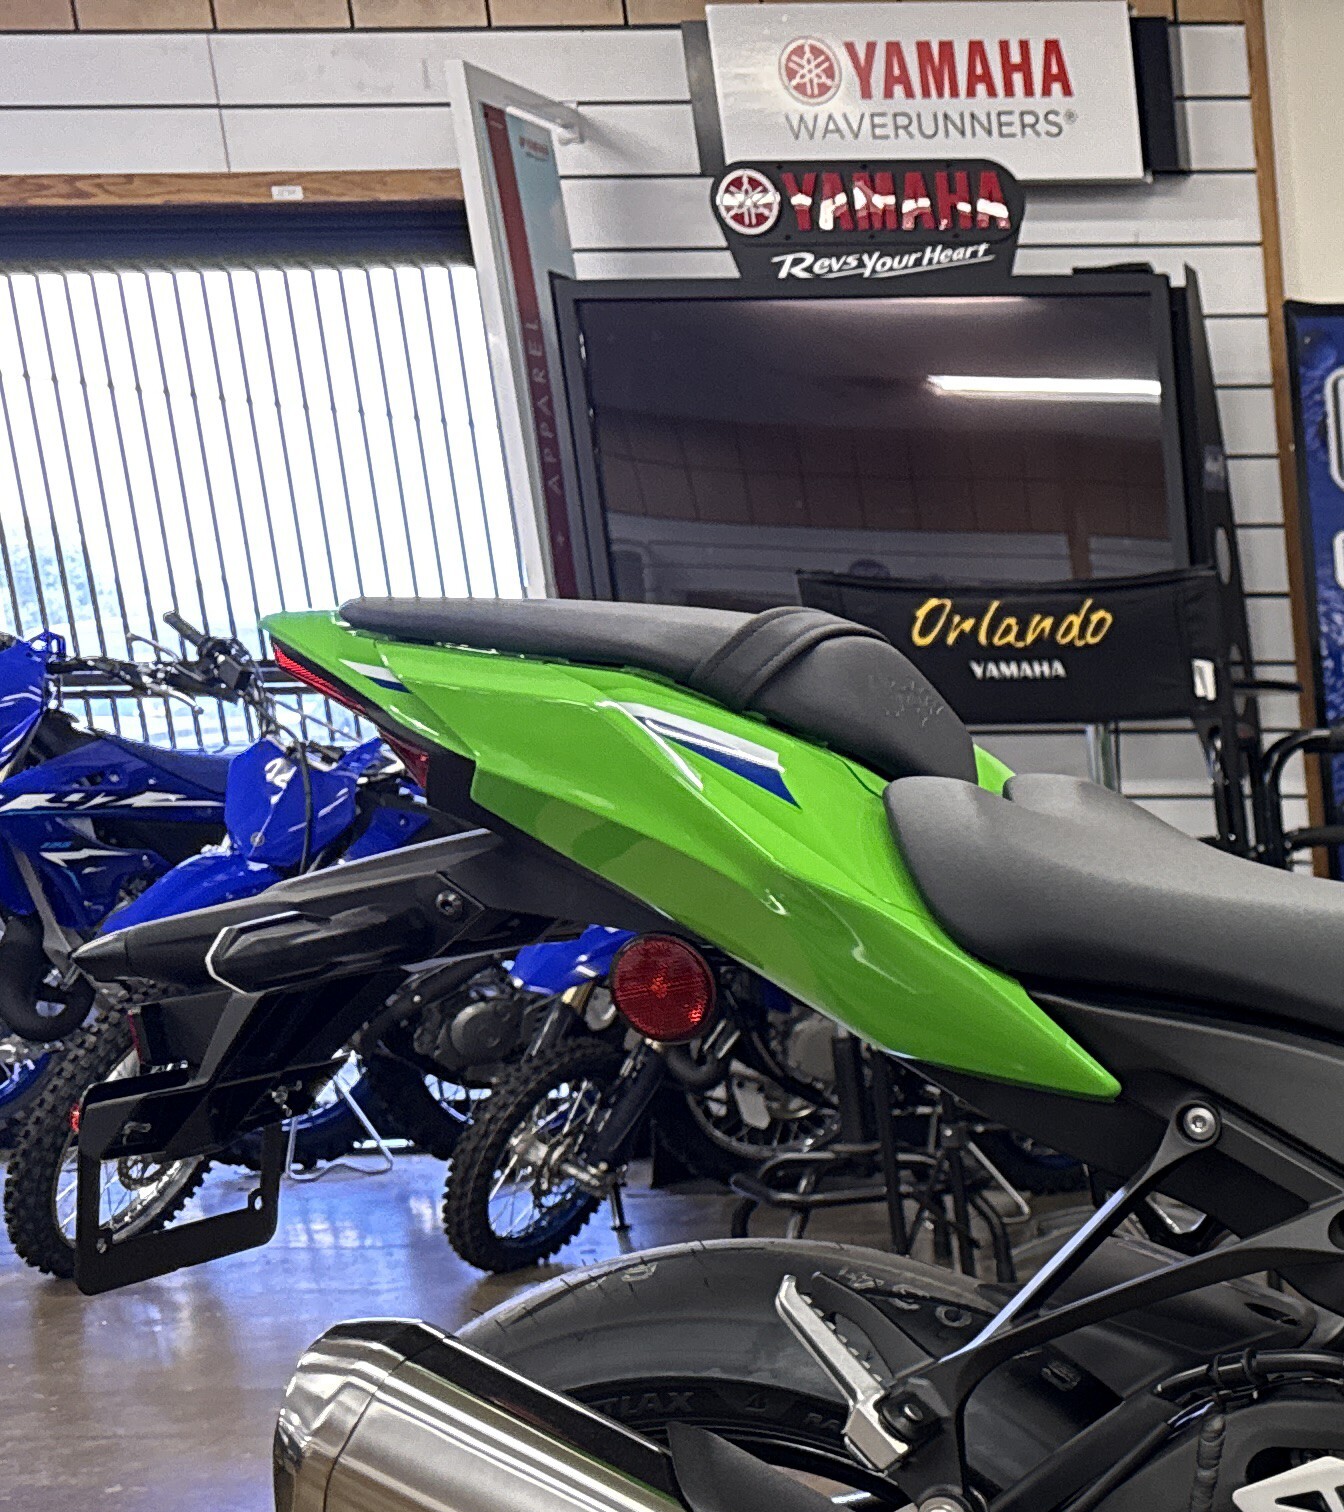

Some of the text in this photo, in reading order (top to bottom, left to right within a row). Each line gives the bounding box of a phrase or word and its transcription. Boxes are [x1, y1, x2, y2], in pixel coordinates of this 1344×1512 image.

[843, 39, 1074, 100] YAMAHA
[781, 170, 1010, 231] YAMAHA
[771, 242, 991, 279] Revs Your Heart
[524, 320, 563, 496] APPAREL
[911, 597, 1114, 647] Orlando
[969, 659, 1067, 680] YAMAHA
